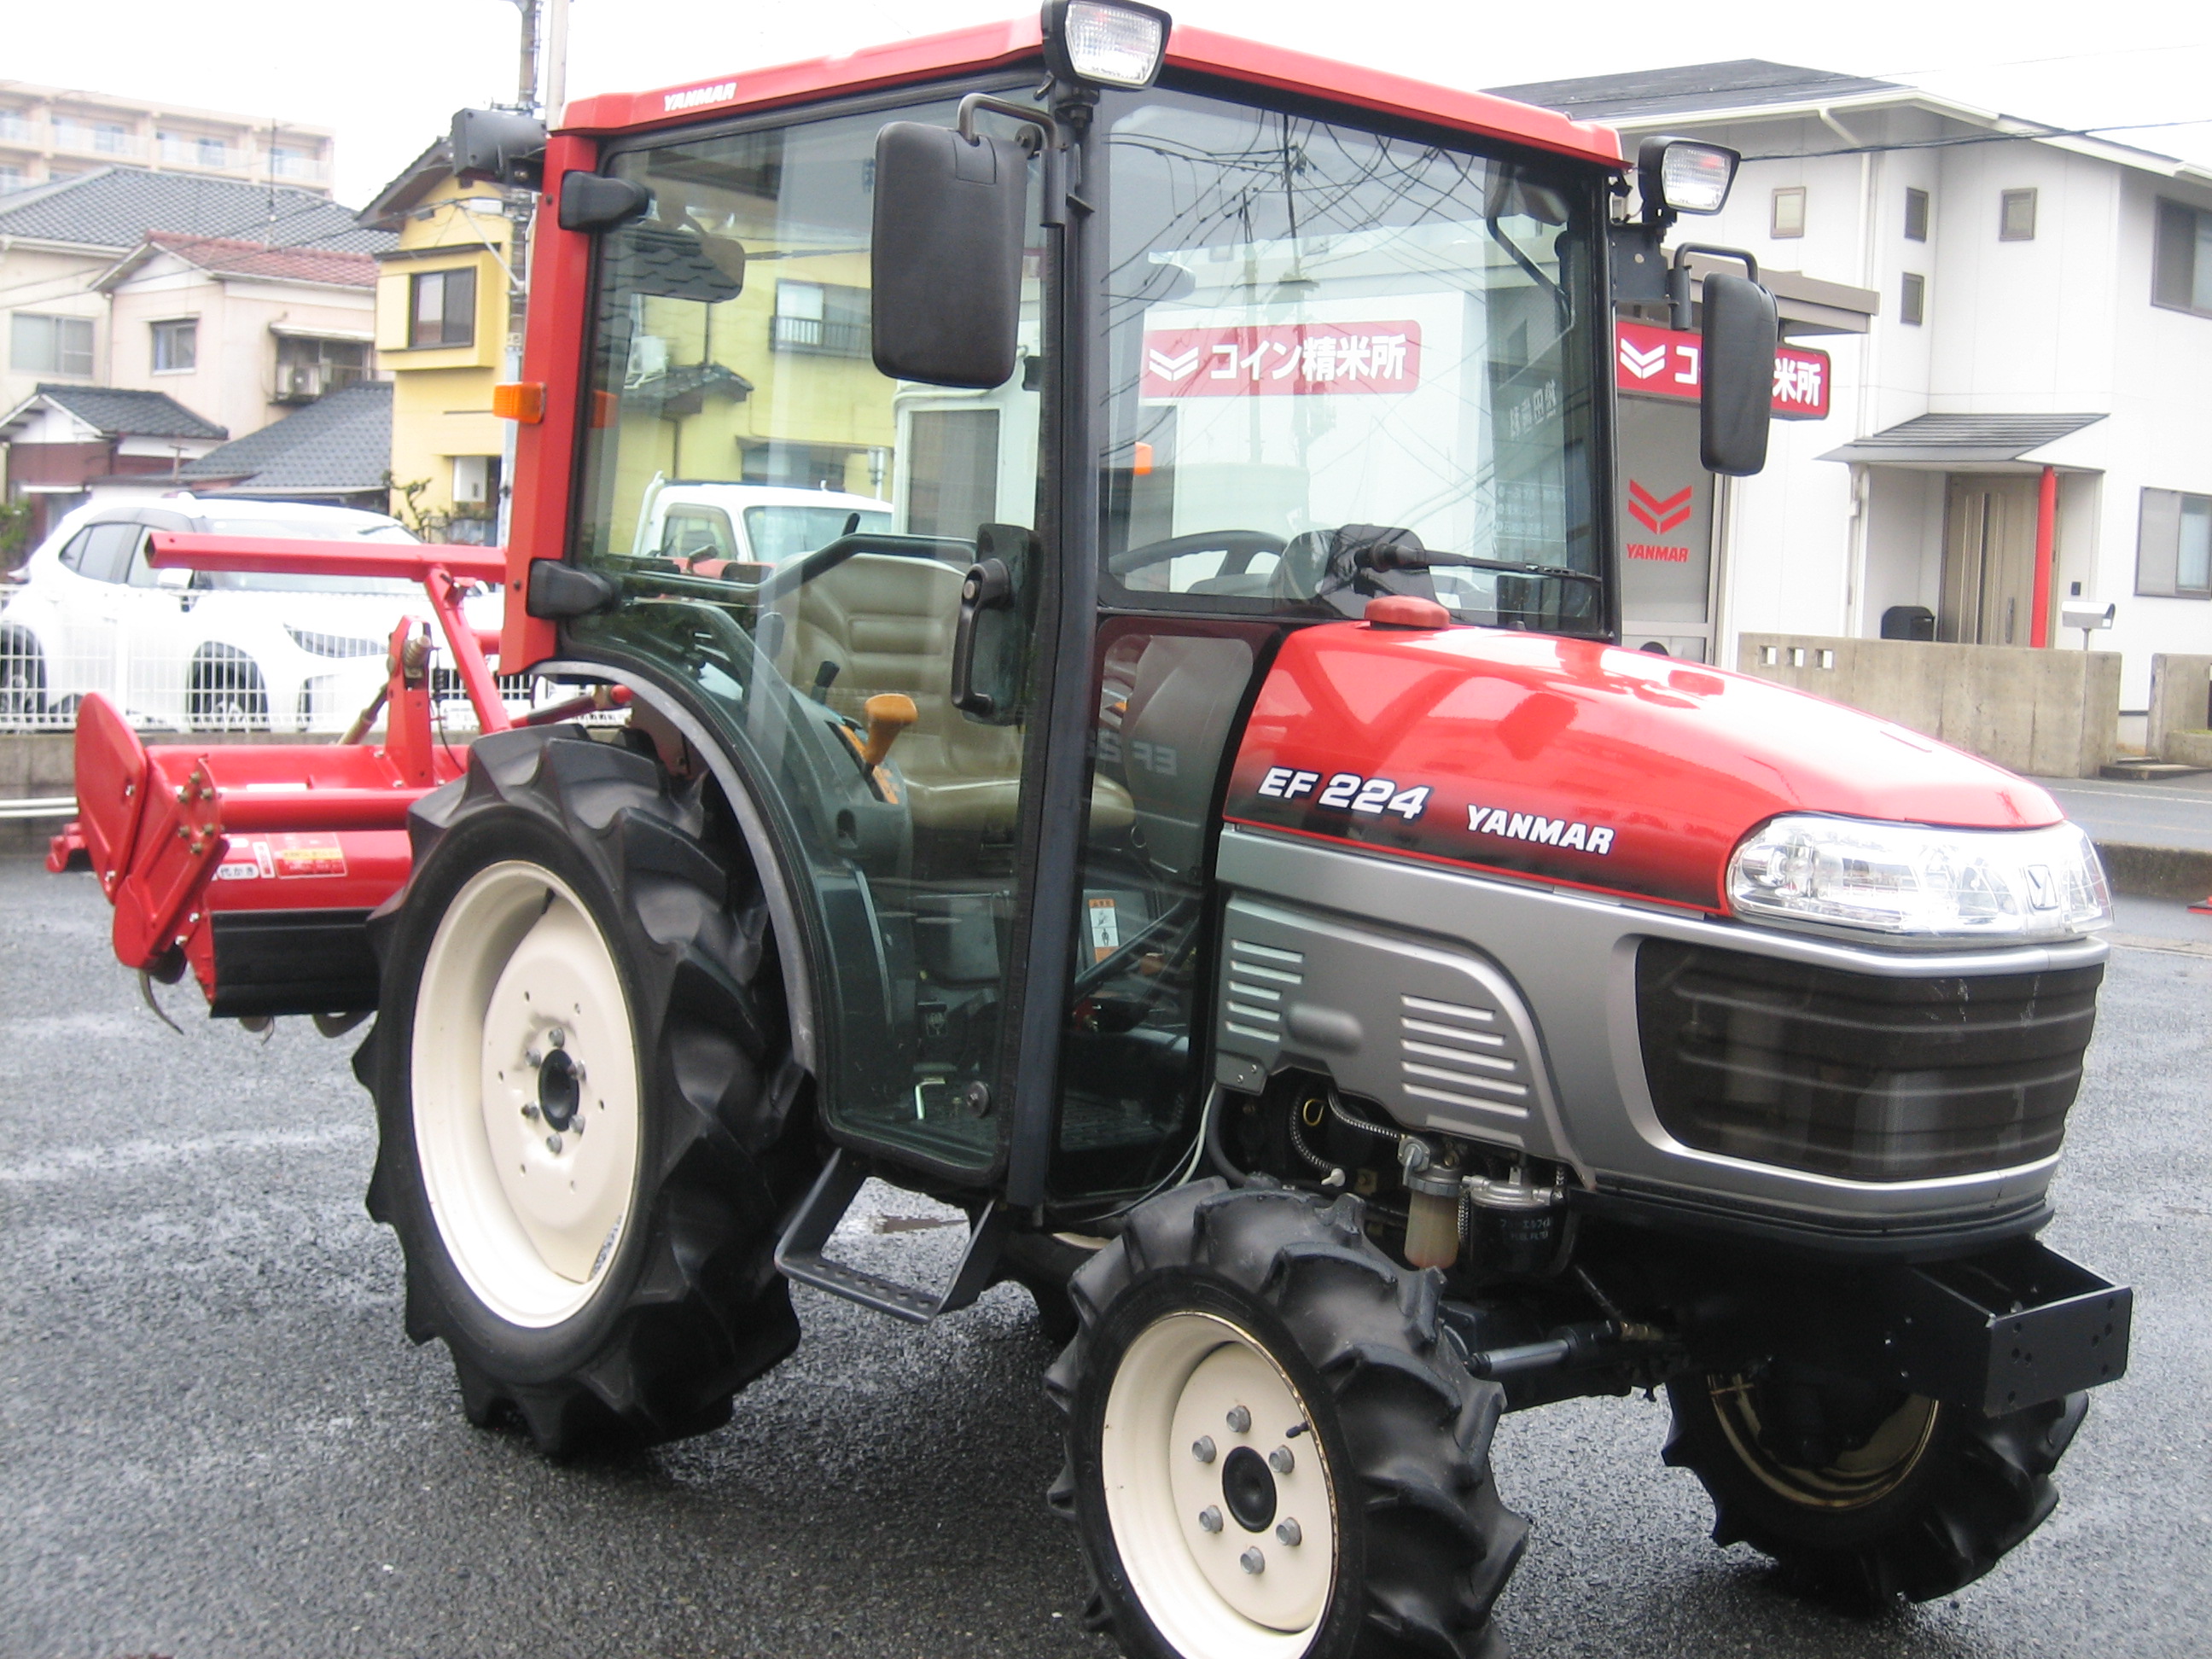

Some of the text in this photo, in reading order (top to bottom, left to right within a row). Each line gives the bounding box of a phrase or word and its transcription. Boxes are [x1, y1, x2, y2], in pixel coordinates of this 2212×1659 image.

[664, 82, 737, 112] YANMAR
[1210, 334, 1406, 381] コイン精米所
[1627, 543, 1689, 563] YANMAR
[1257, 766, 1432, 821] EF 224
[1467, 804, 1615, 855] YANMAR
